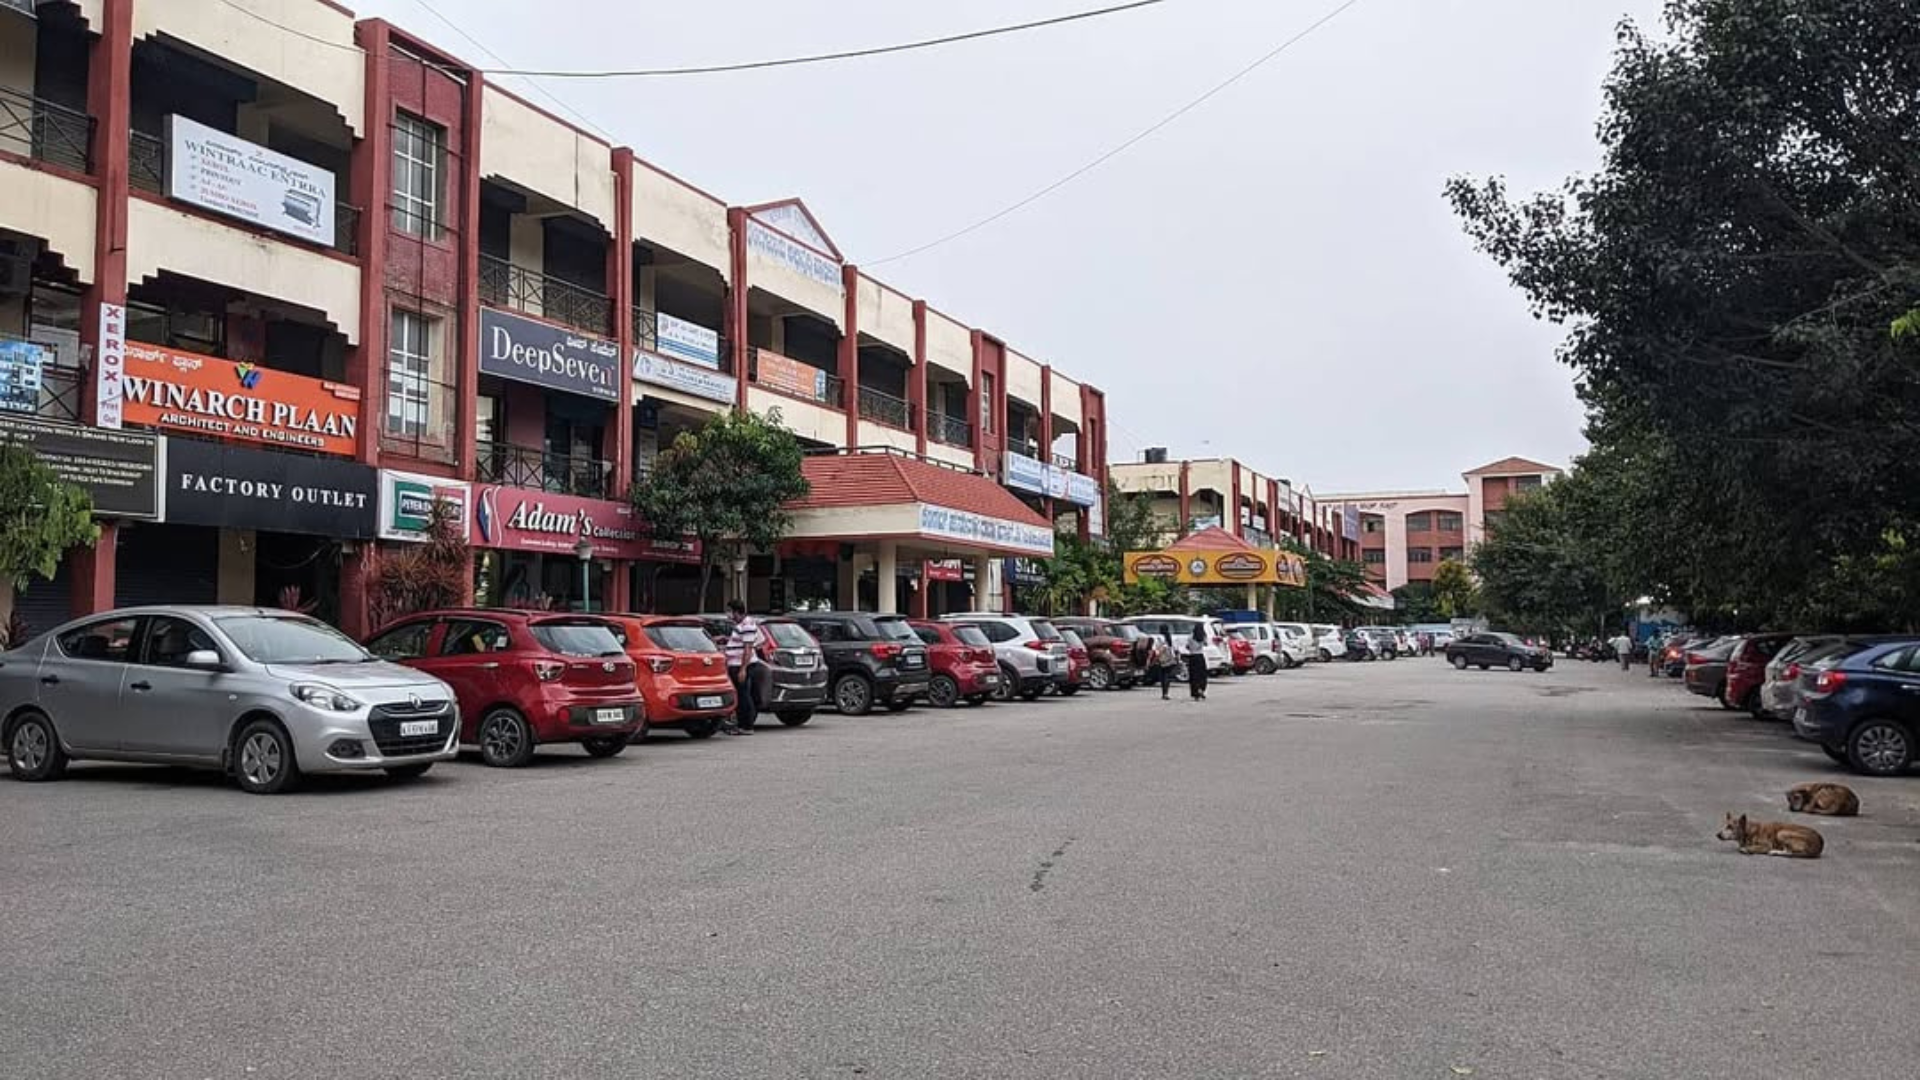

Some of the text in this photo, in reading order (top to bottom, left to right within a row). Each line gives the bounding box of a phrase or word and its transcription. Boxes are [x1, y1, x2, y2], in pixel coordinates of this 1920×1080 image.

[184, 139, 268, 177] WINTRAAC
[104, 306, 121, 383] XEROX
[490, 325, 612, 386] DeepSeven
[123, 375, 357, 438] WINARCH PLAAN
[161, 413, 325, 448] ARCHITECT AND ENGINEERS
[181, 473, 367, 508] FACTORY OUTLET
[508, 500, 594, 536] Adam's
